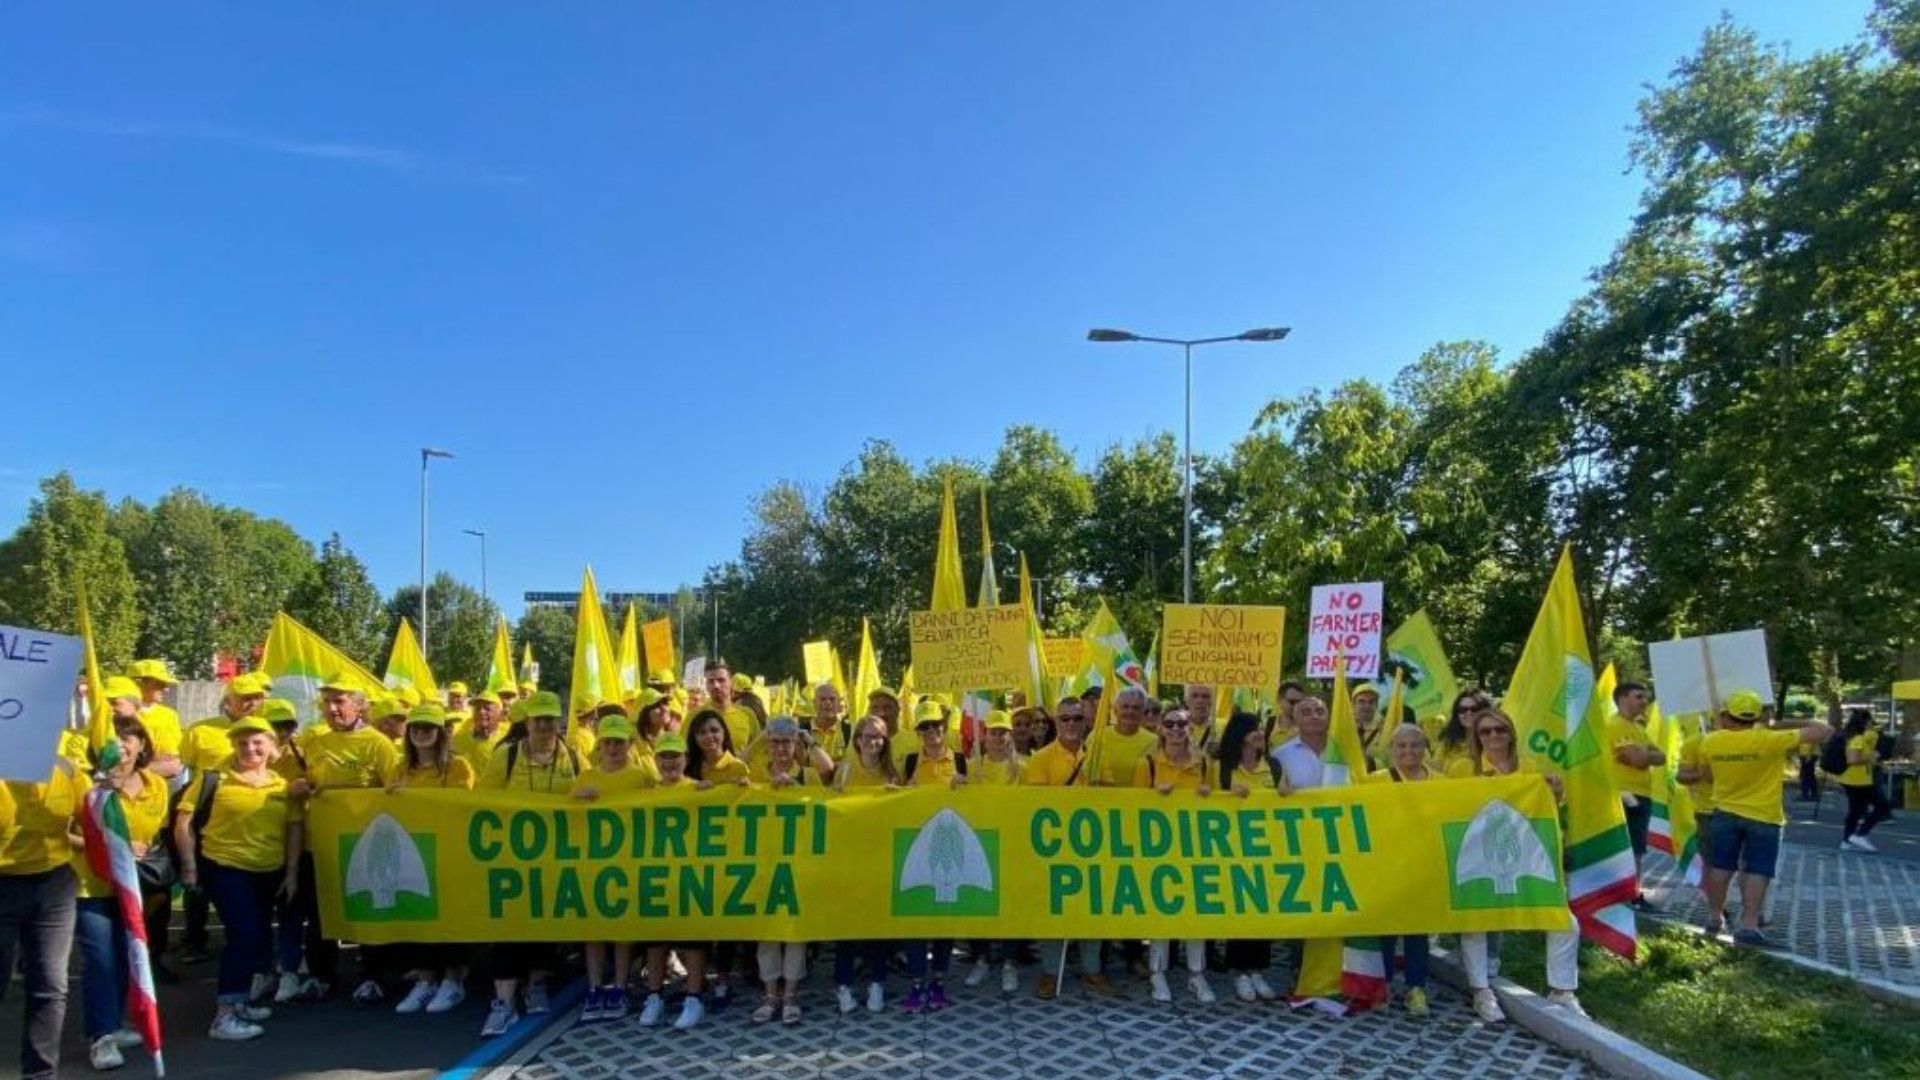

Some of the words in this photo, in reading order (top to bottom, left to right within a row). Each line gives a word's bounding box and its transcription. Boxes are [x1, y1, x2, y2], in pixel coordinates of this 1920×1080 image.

[1329, 591, 1363, 611] NO
[1200, 608, 1243, 630] NOI
[1311, 612, 1380, 635] FARMER
[1167, 629, 1277, 647] SEMINIAMO
[1326, 634, 1360, 652] NO
[1166, 650, 1171, 662] I
[1176, 649, 1262, 666] CINGHIALI
[1164, 665, 1269, 686] RACCOLGONO
[469, 804, 826, 861] COLDIRETTI
[1030, 804, 1371, 859] COLDIRETTI
[488, 862, 799, 919] PIACENZA
[1049, 861, 1358, 916] PIACENZA
